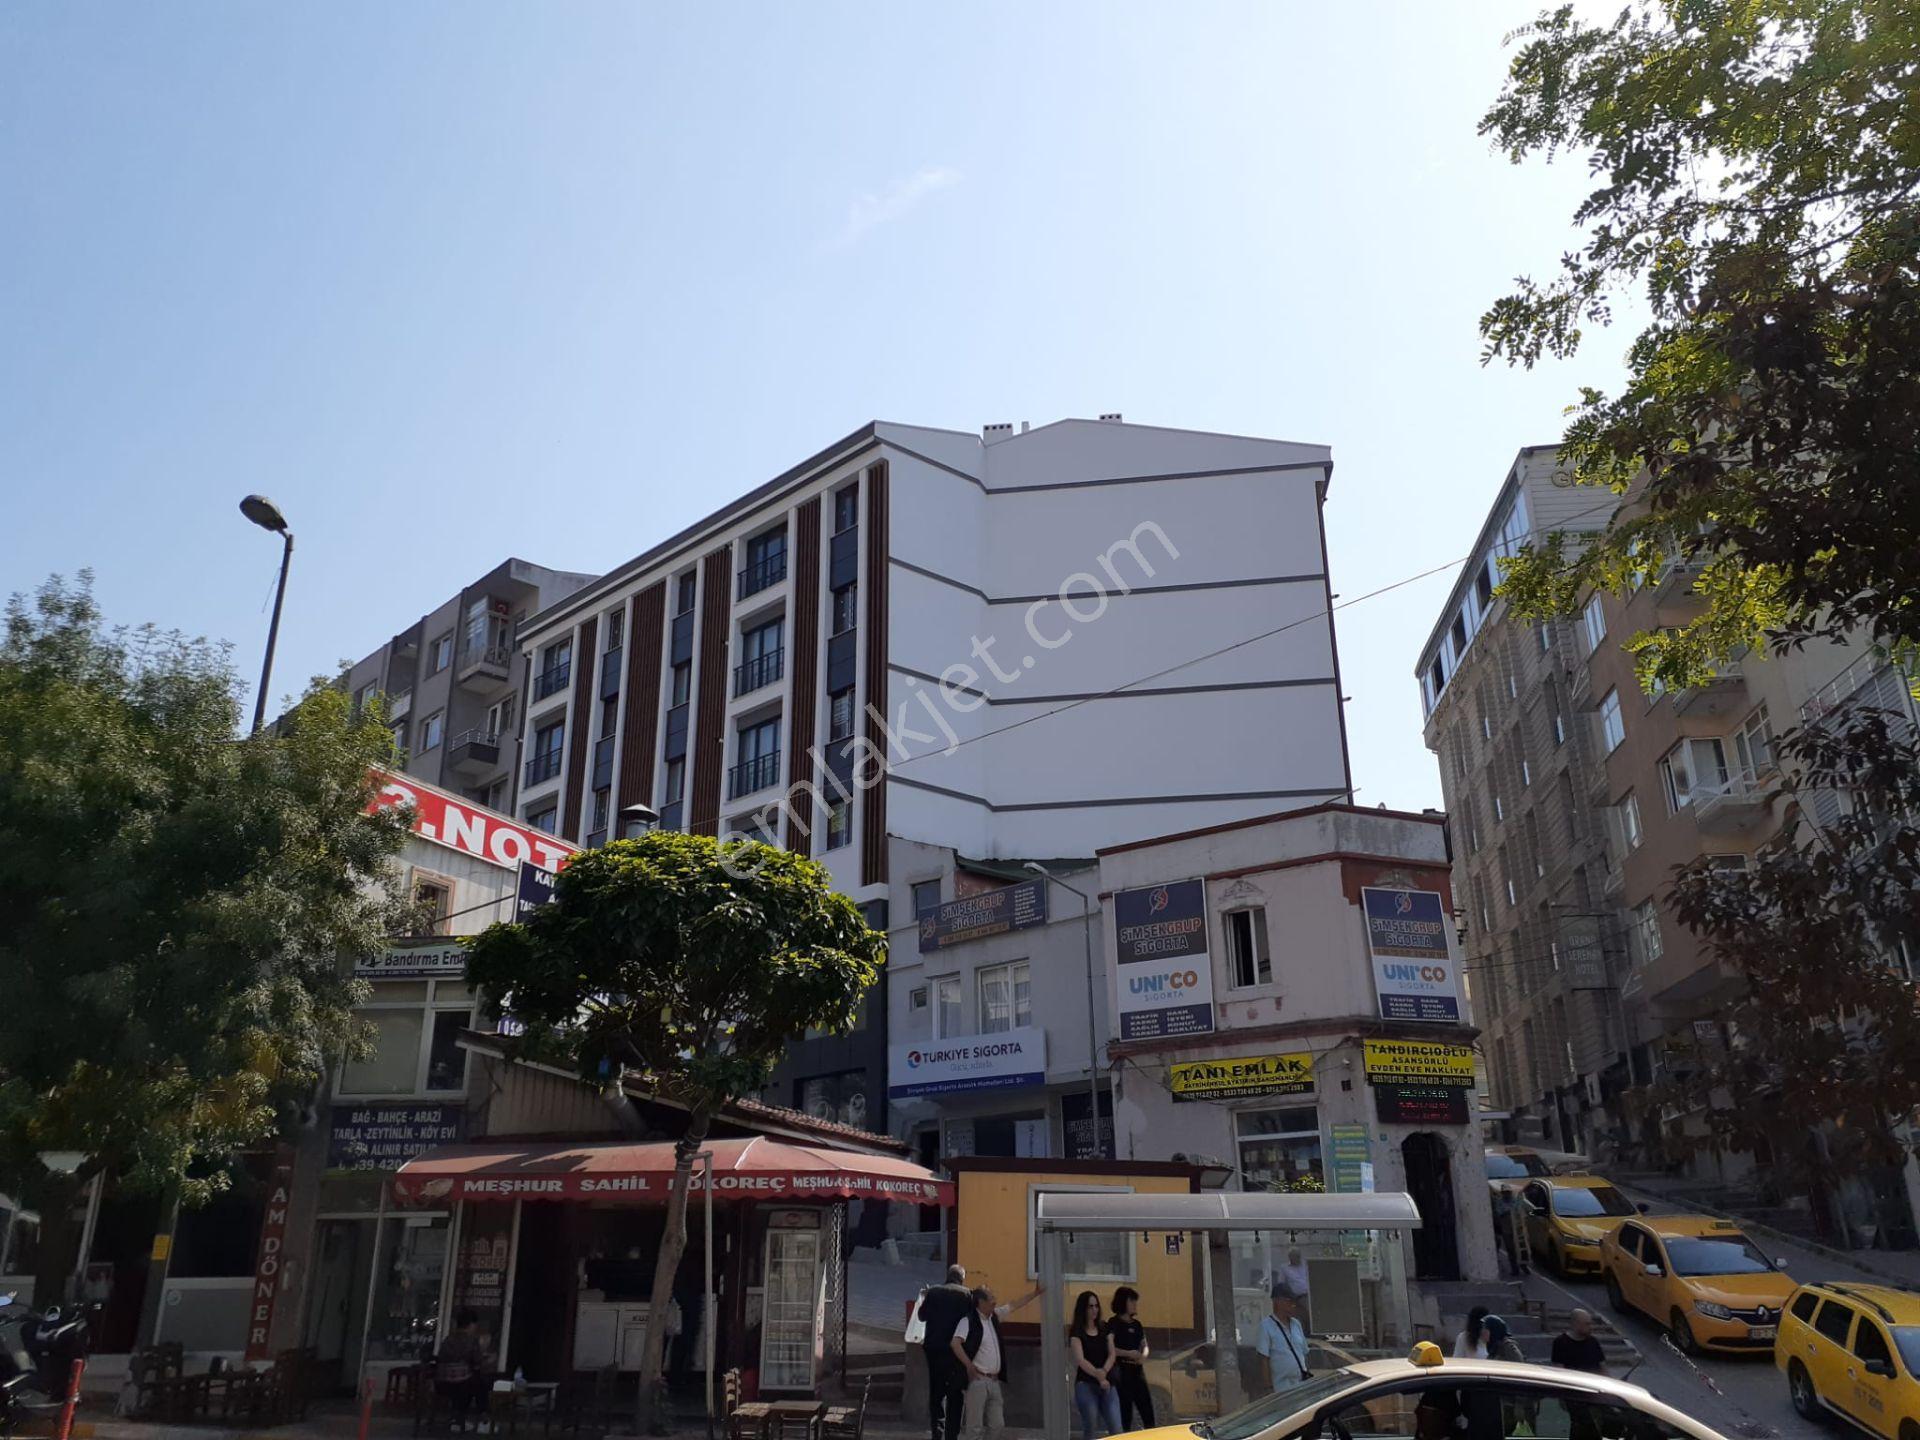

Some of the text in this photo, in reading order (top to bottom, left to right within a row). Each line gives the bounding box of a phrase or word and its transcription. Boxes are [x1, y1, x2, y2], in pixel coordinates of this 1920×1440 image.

[1232, 1059, 1303, 1077] EMLAK
[1371, 1064, 1401, 1072] EVDEN
[351, 1110, 370, 1123] BAĞ
[377, 1111, 407, 1124] BAHÇE
[414, 1109, 442, 1123] ARAZİ
[420, 1125, 438, 1139] KÖY
[441, 1125, 457, 1139] EVİ
[371, 1143, 401, 1156] ALINIR
[464, 1179, 563, 1196] MEŞHUR
[580, 1175, 651, 1192] SAHİL
[876, 1180, 921, 1197] KOKOREÇ
[251, 1238, 280, 1344] DÖNER
